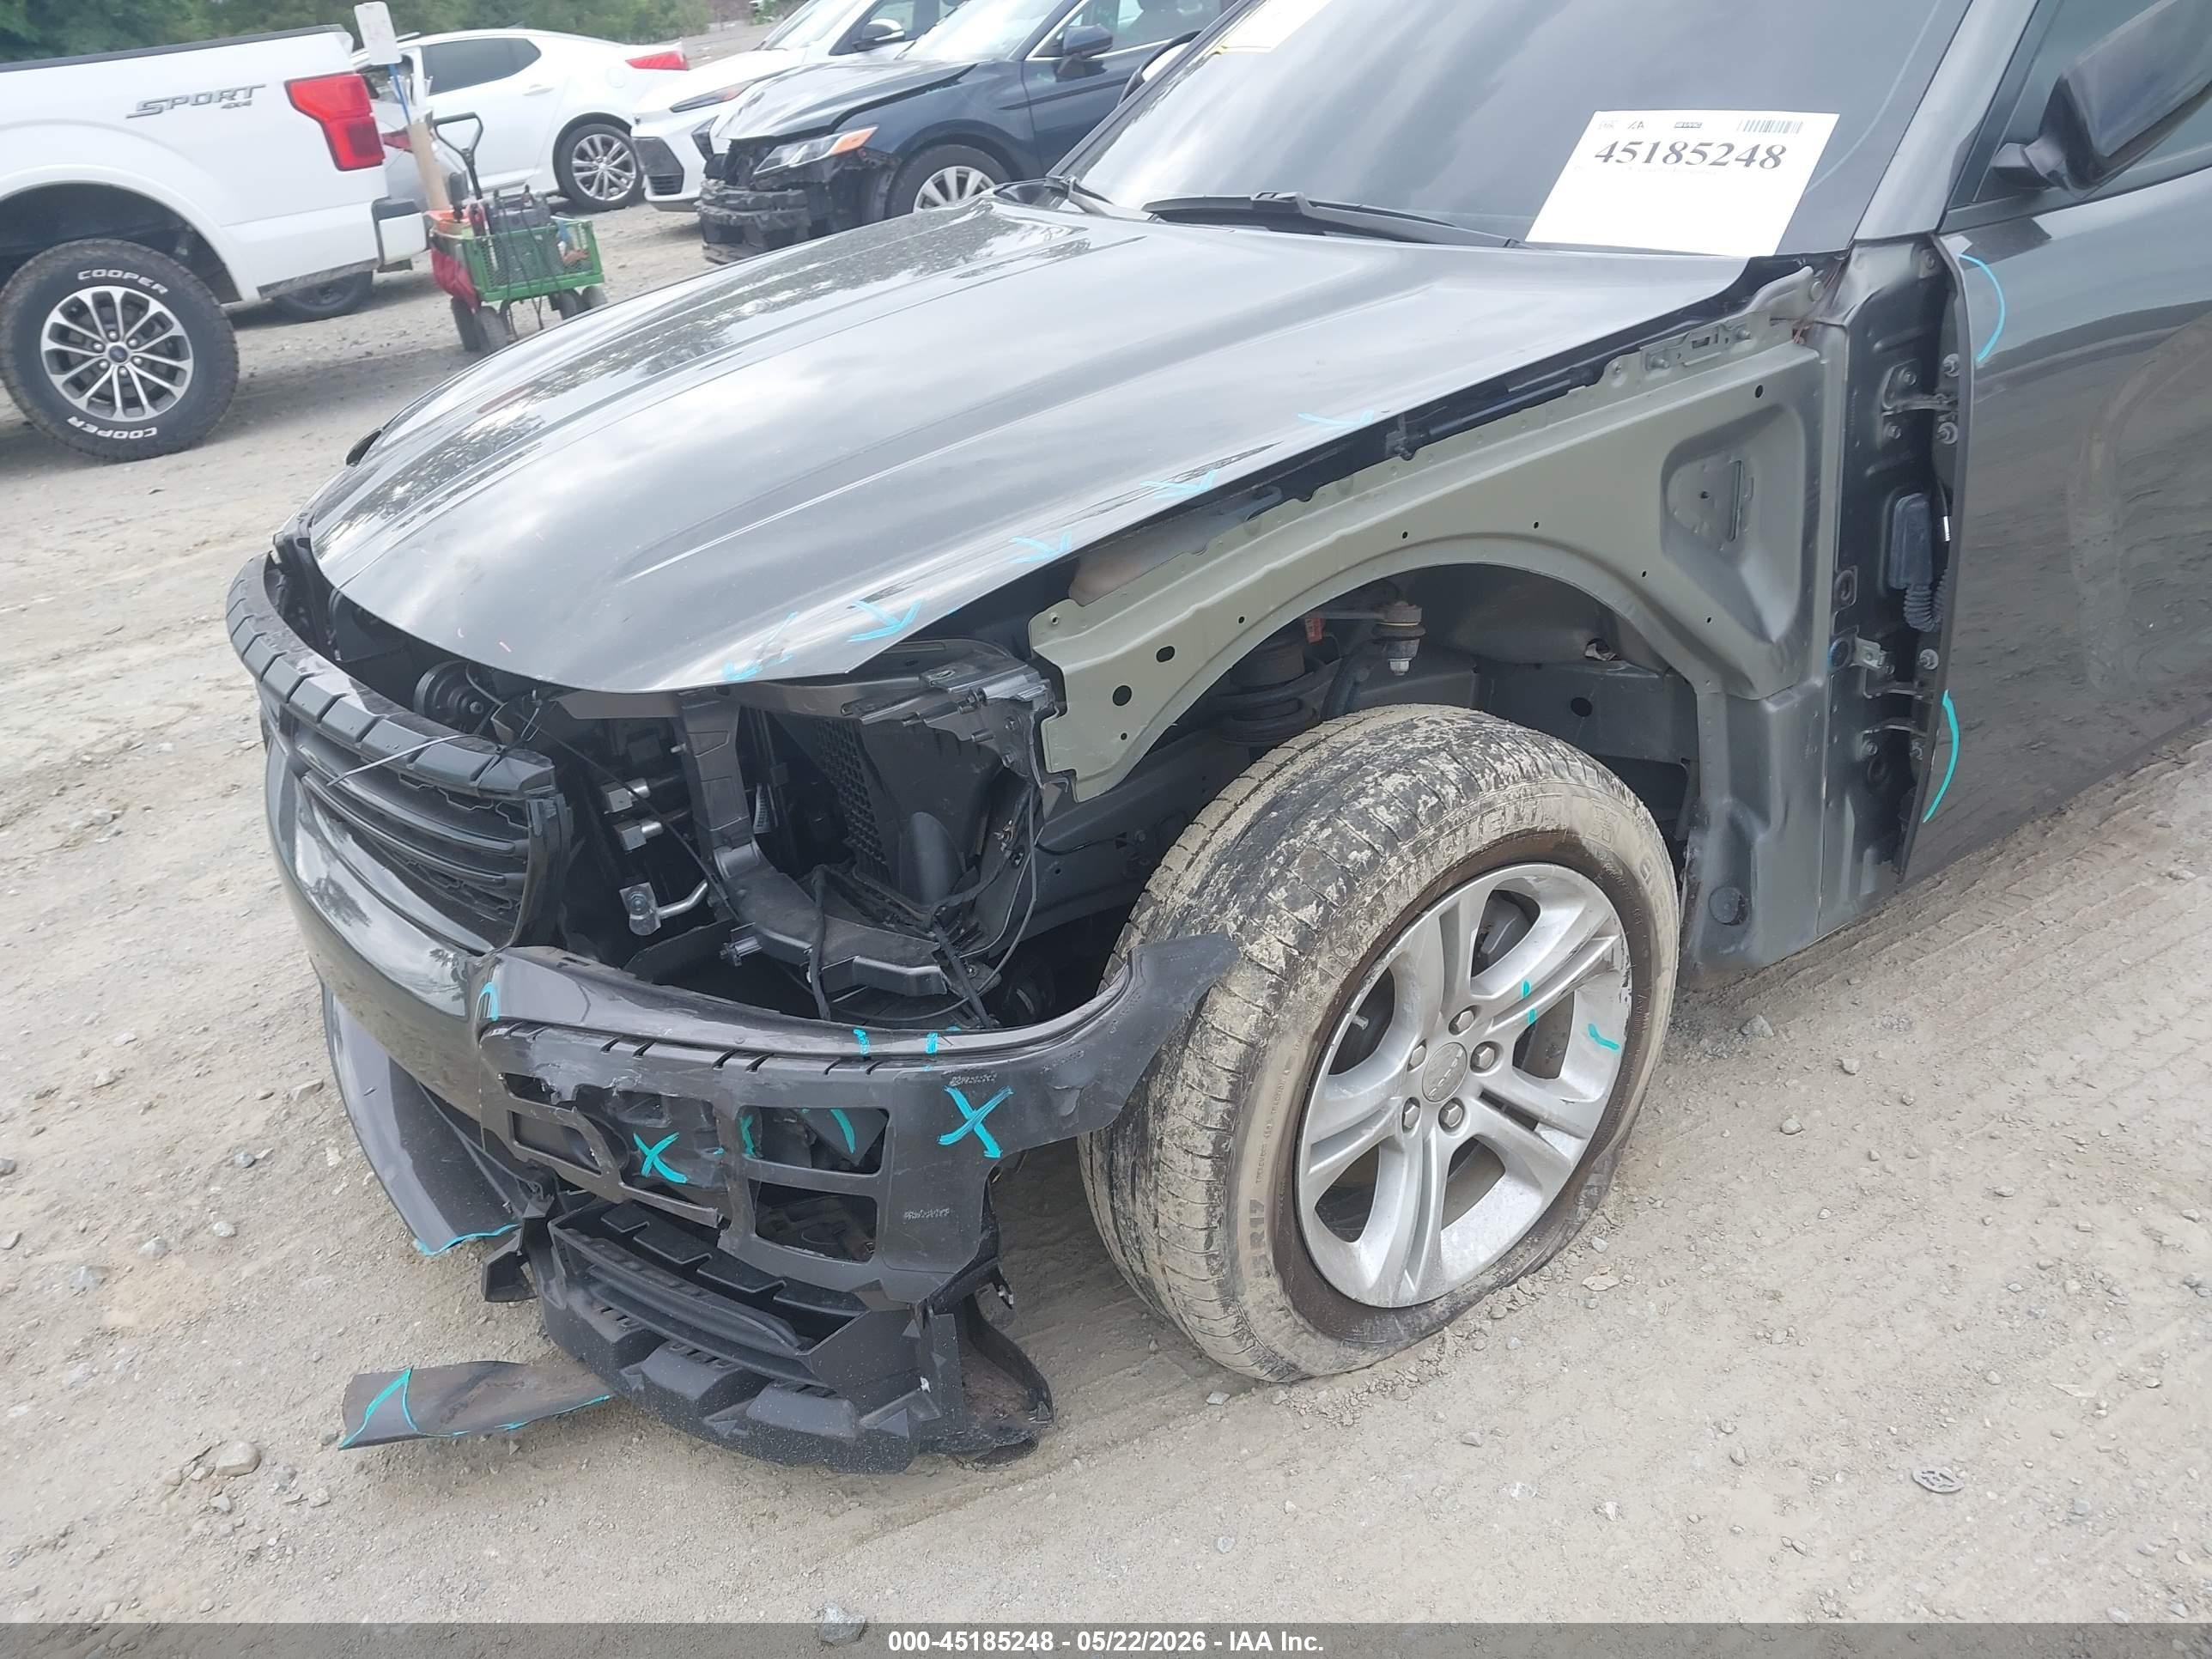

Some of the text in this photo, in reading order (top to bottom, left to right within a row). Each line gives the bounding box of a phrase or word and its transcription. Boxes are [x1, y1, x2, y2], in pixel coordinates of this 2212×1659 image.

[125, 84, 267, 118] SPORT
[1594, 140, 1787, 170] 45185248
[77, 269, 168, 294] COOPER
[67, 416, 158, 439] COOPER
